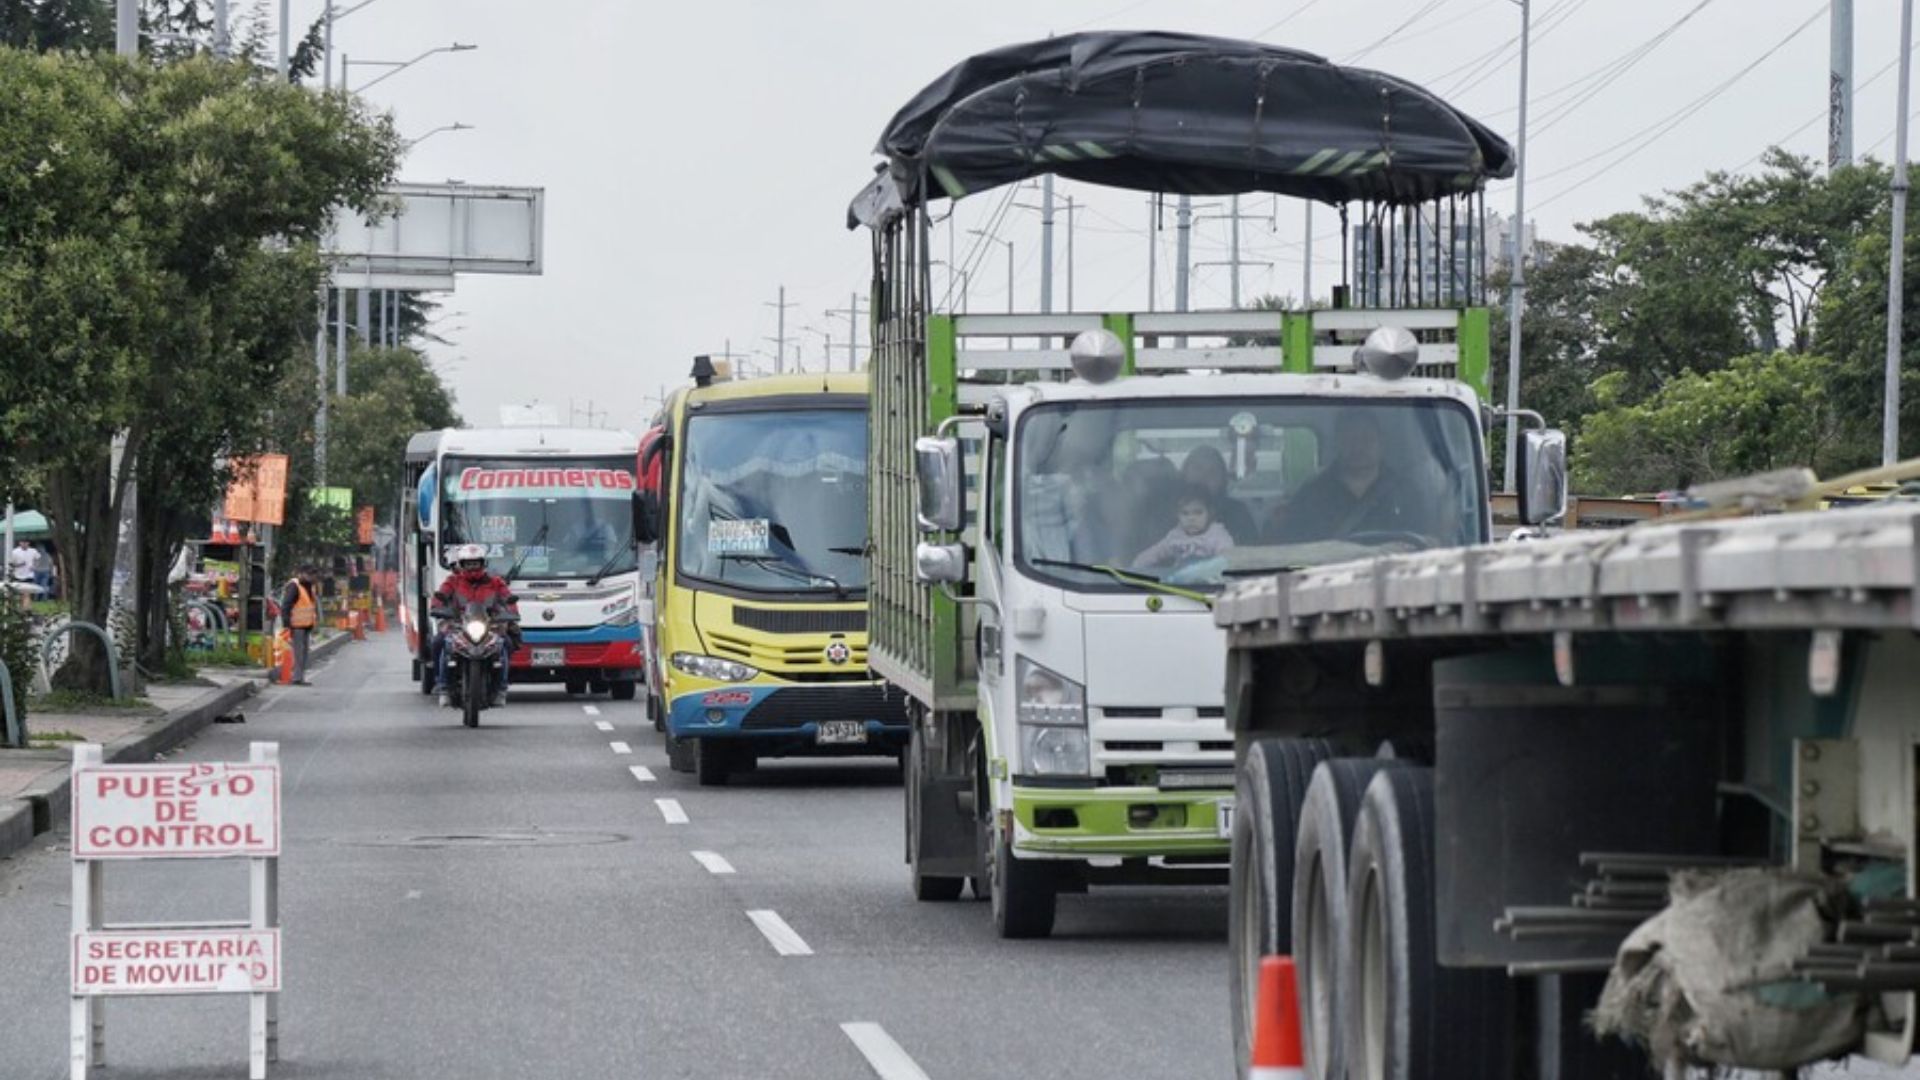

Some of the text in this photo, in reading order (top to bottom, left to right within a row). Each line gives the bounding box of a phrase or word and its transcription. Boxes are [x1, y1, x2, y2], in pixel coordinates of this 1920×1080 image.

[460, 467, 633, 491] Comuneros
[155, 800, 198, 822] DE
[89, 824, 263, 847] CONTROL
[84, 962, 268, 984] DE MOVILID
